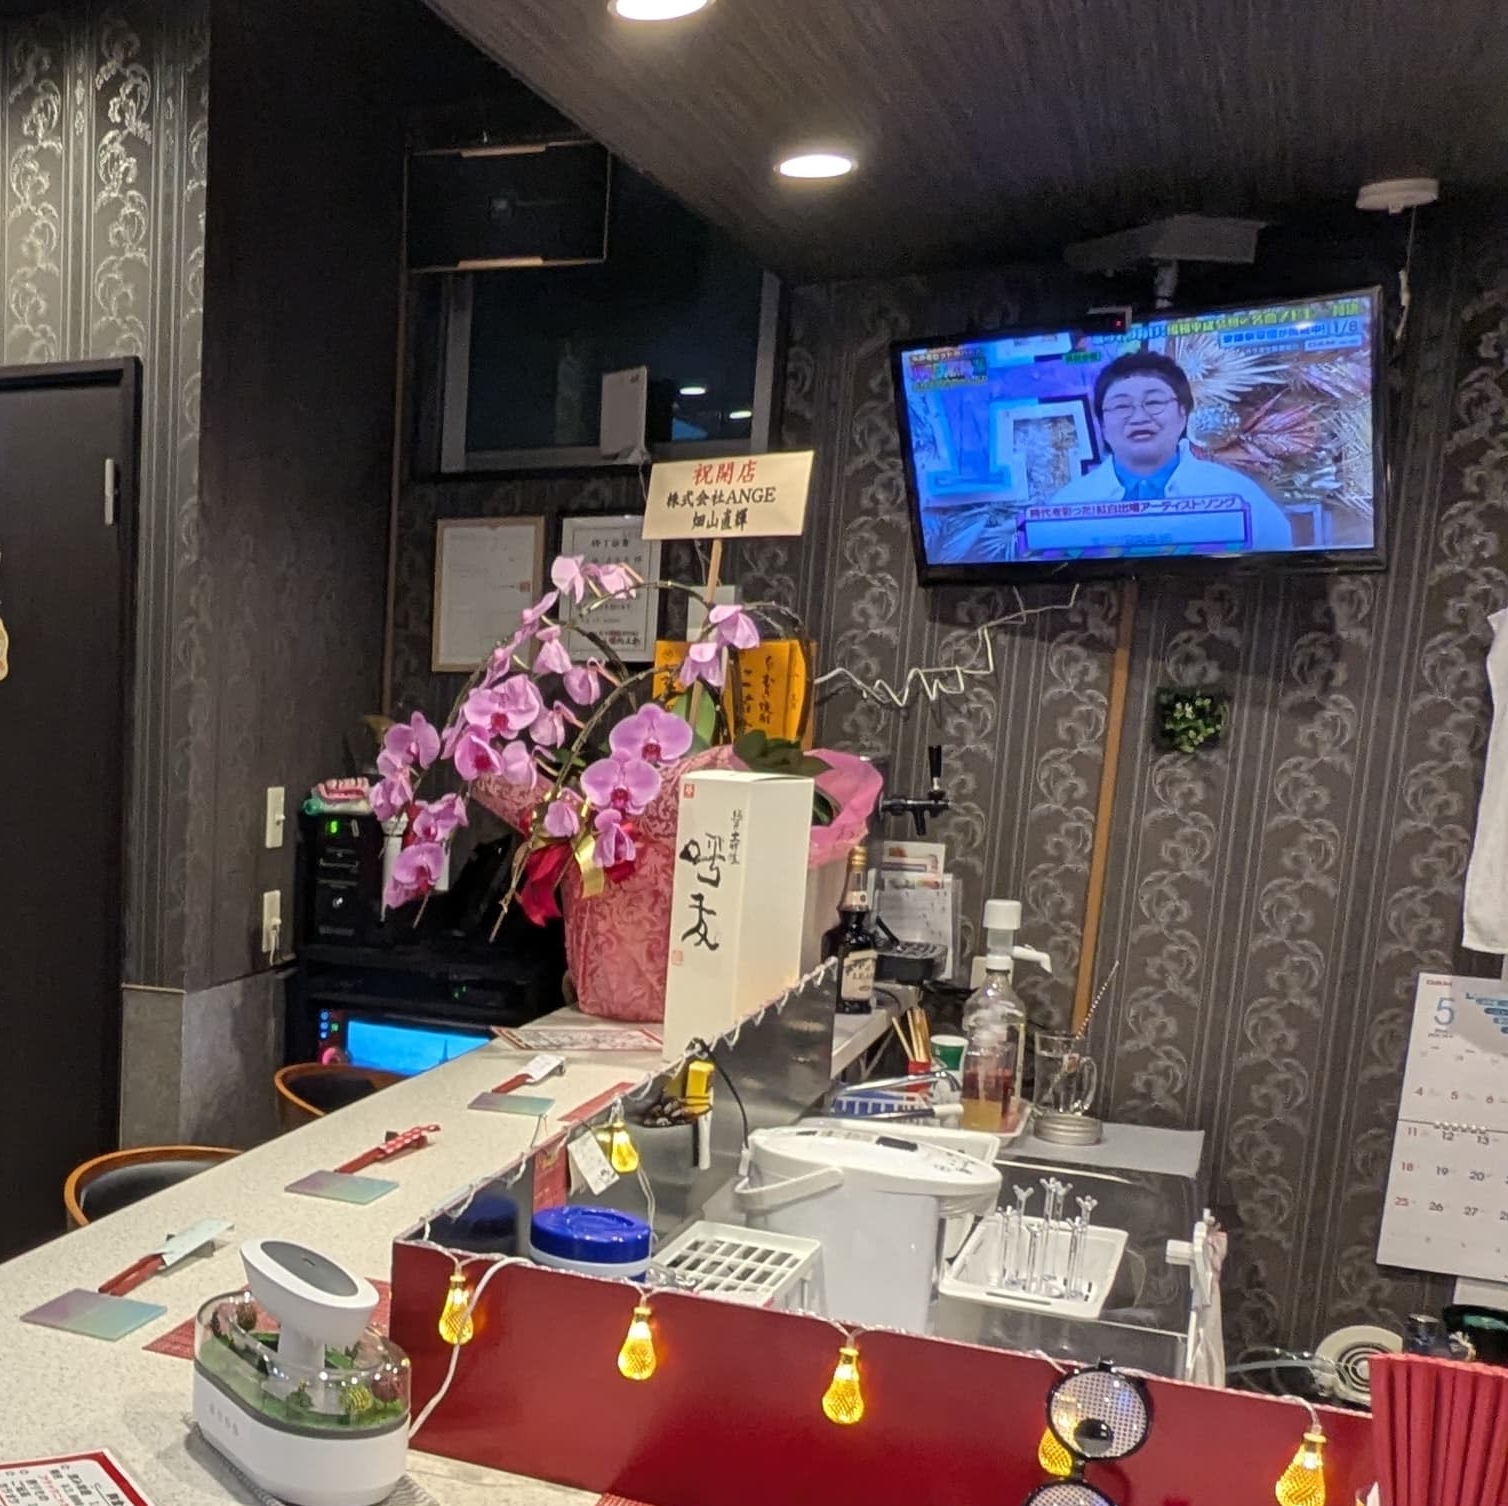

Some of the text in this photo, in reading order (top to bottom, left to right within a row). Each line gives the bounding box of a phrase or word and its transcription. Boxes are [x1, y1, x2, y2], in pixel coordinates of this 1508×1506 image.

[693, 459, 758, 486] 祝開店
[666, 487, 777, 509] 株式会社ANGE
